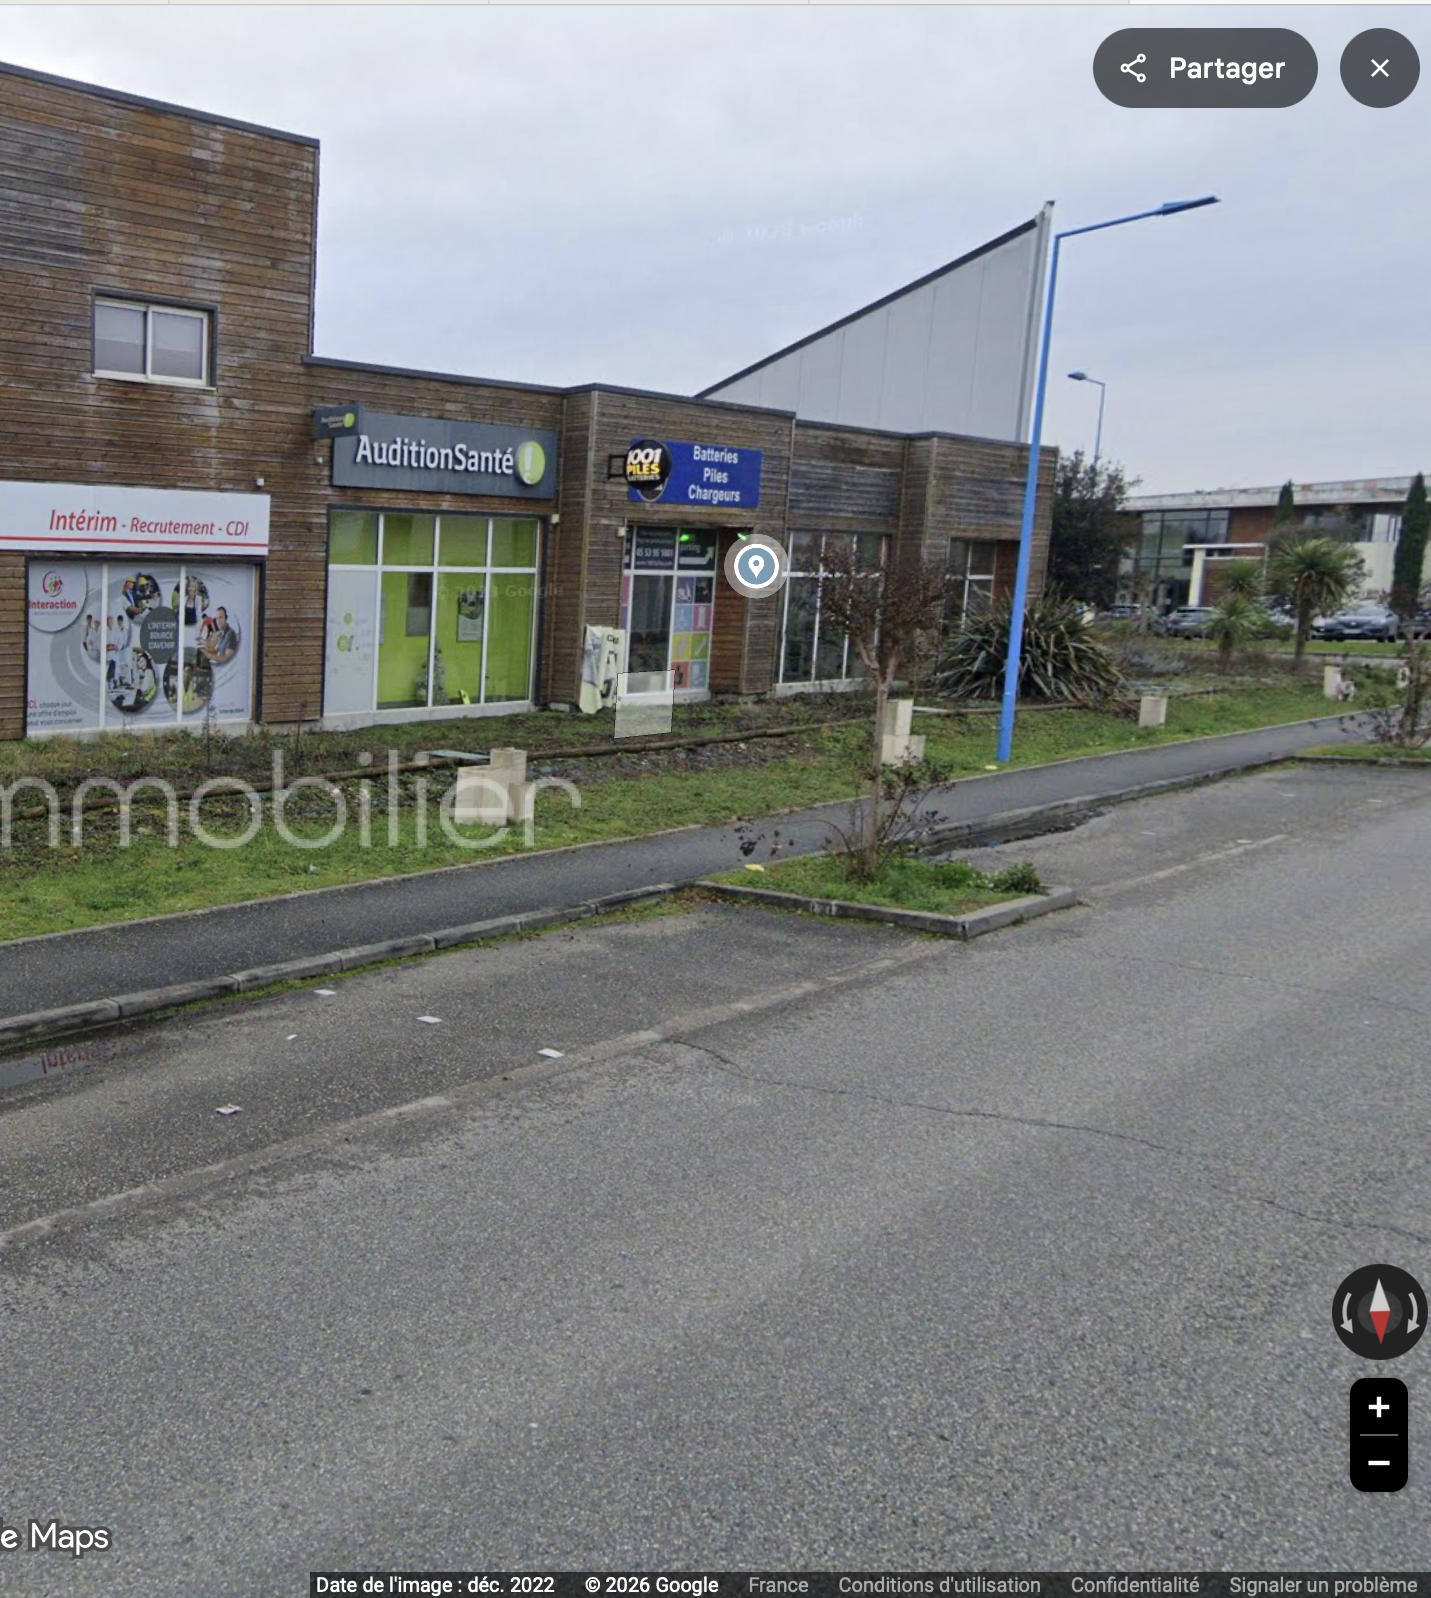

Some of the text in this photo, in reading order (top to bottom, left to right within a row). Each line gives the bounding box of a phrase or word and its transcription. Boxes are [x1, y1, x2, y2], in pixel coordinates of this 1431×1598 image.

[355, 435, 514, 475] AuditionSanté
[627, 448, 662, 464] 1001
[693, 446, 739, 464] Batteries
[626, 463, 660, 475] PILES
[703, 467, 728, 484] Piles
[688, 484, 741, 504] Chargeurs
[49, 509, 118, 532] Intérim
[130, 516, 215, 535] Recrutement
[225, 520, 249, 537] CDI
